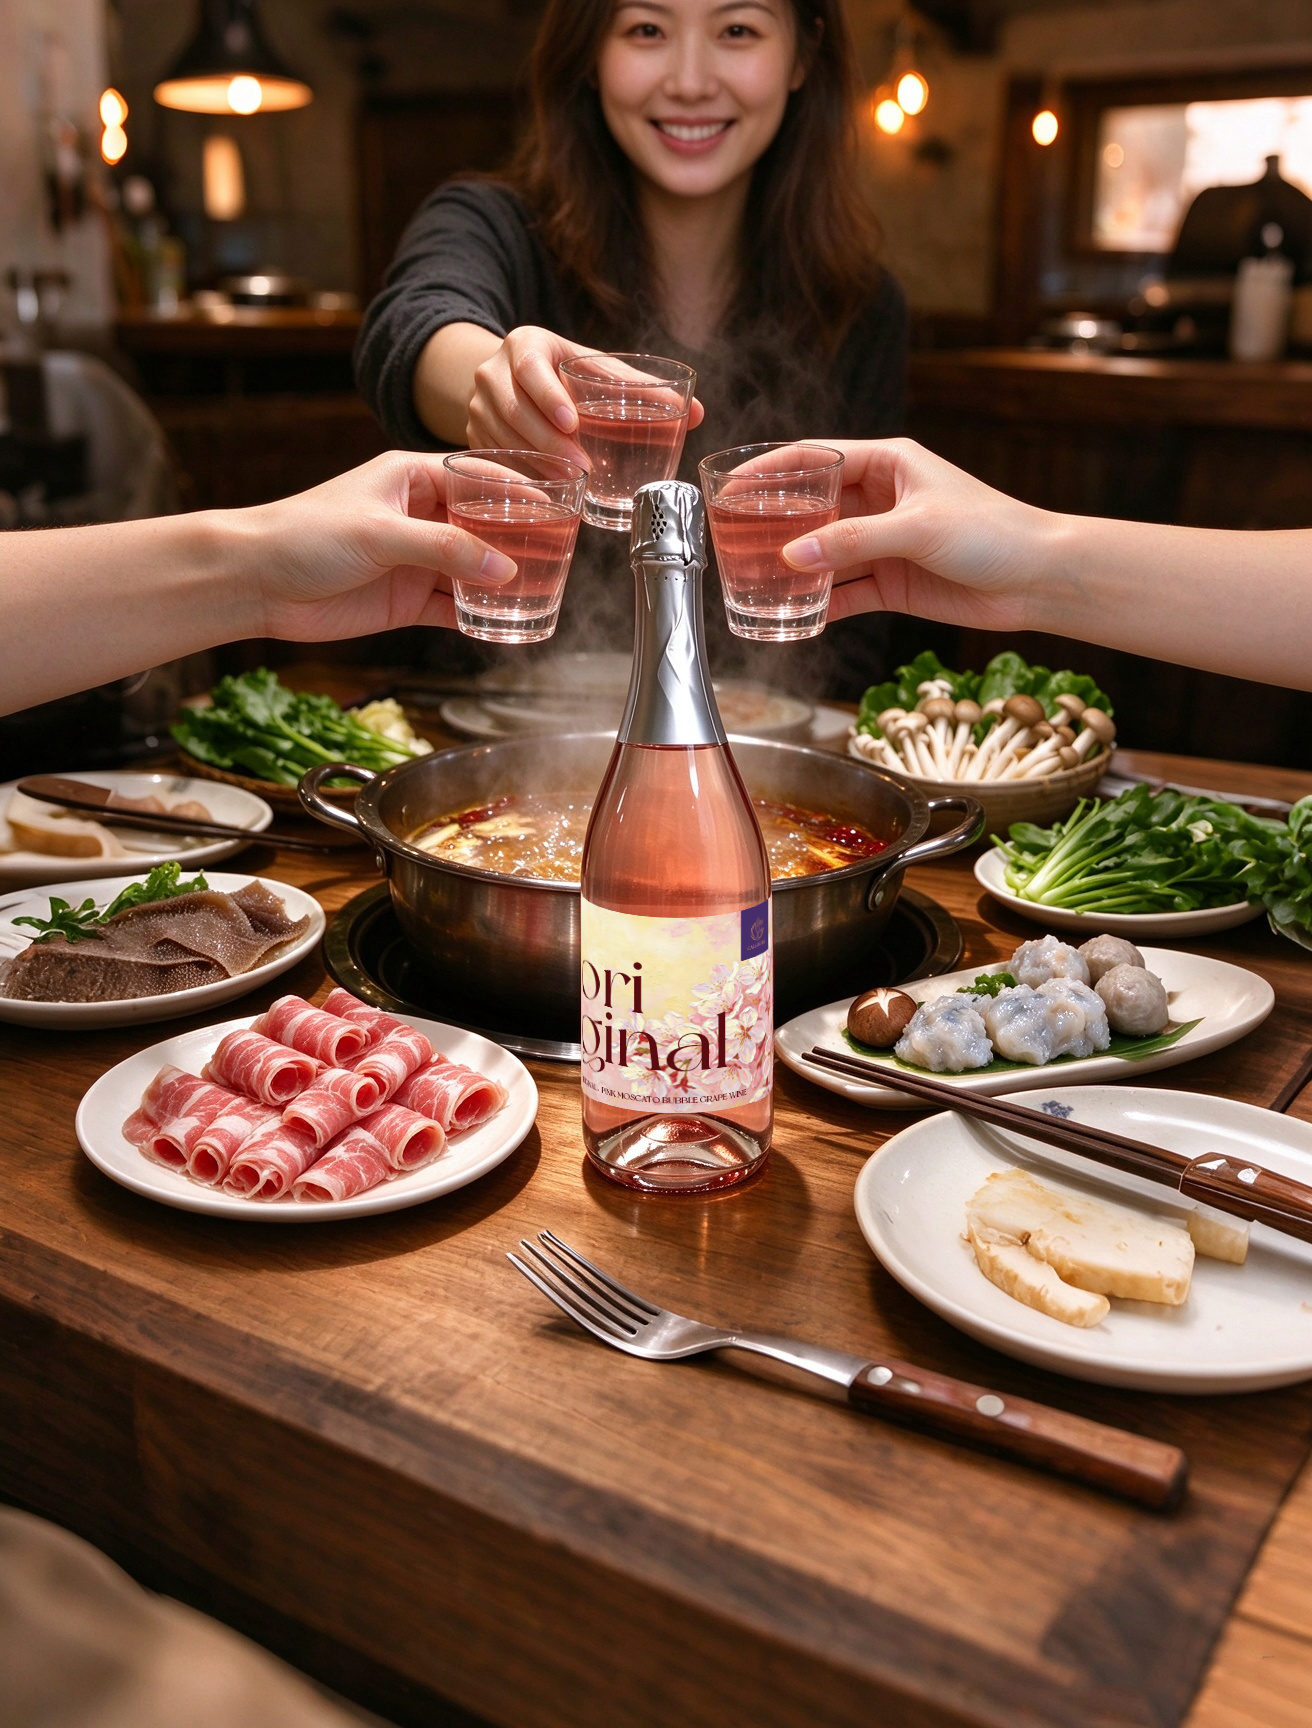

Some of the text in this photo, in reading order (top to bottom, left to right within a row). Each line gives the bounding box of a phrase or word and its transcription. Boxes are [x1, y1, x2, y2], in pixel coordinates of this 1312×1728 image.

[583, 1012, 728, 1072] ginal
[601, 1086, 748, 1104] PINK MOSCATO BUBBLE GRAPE WINE
